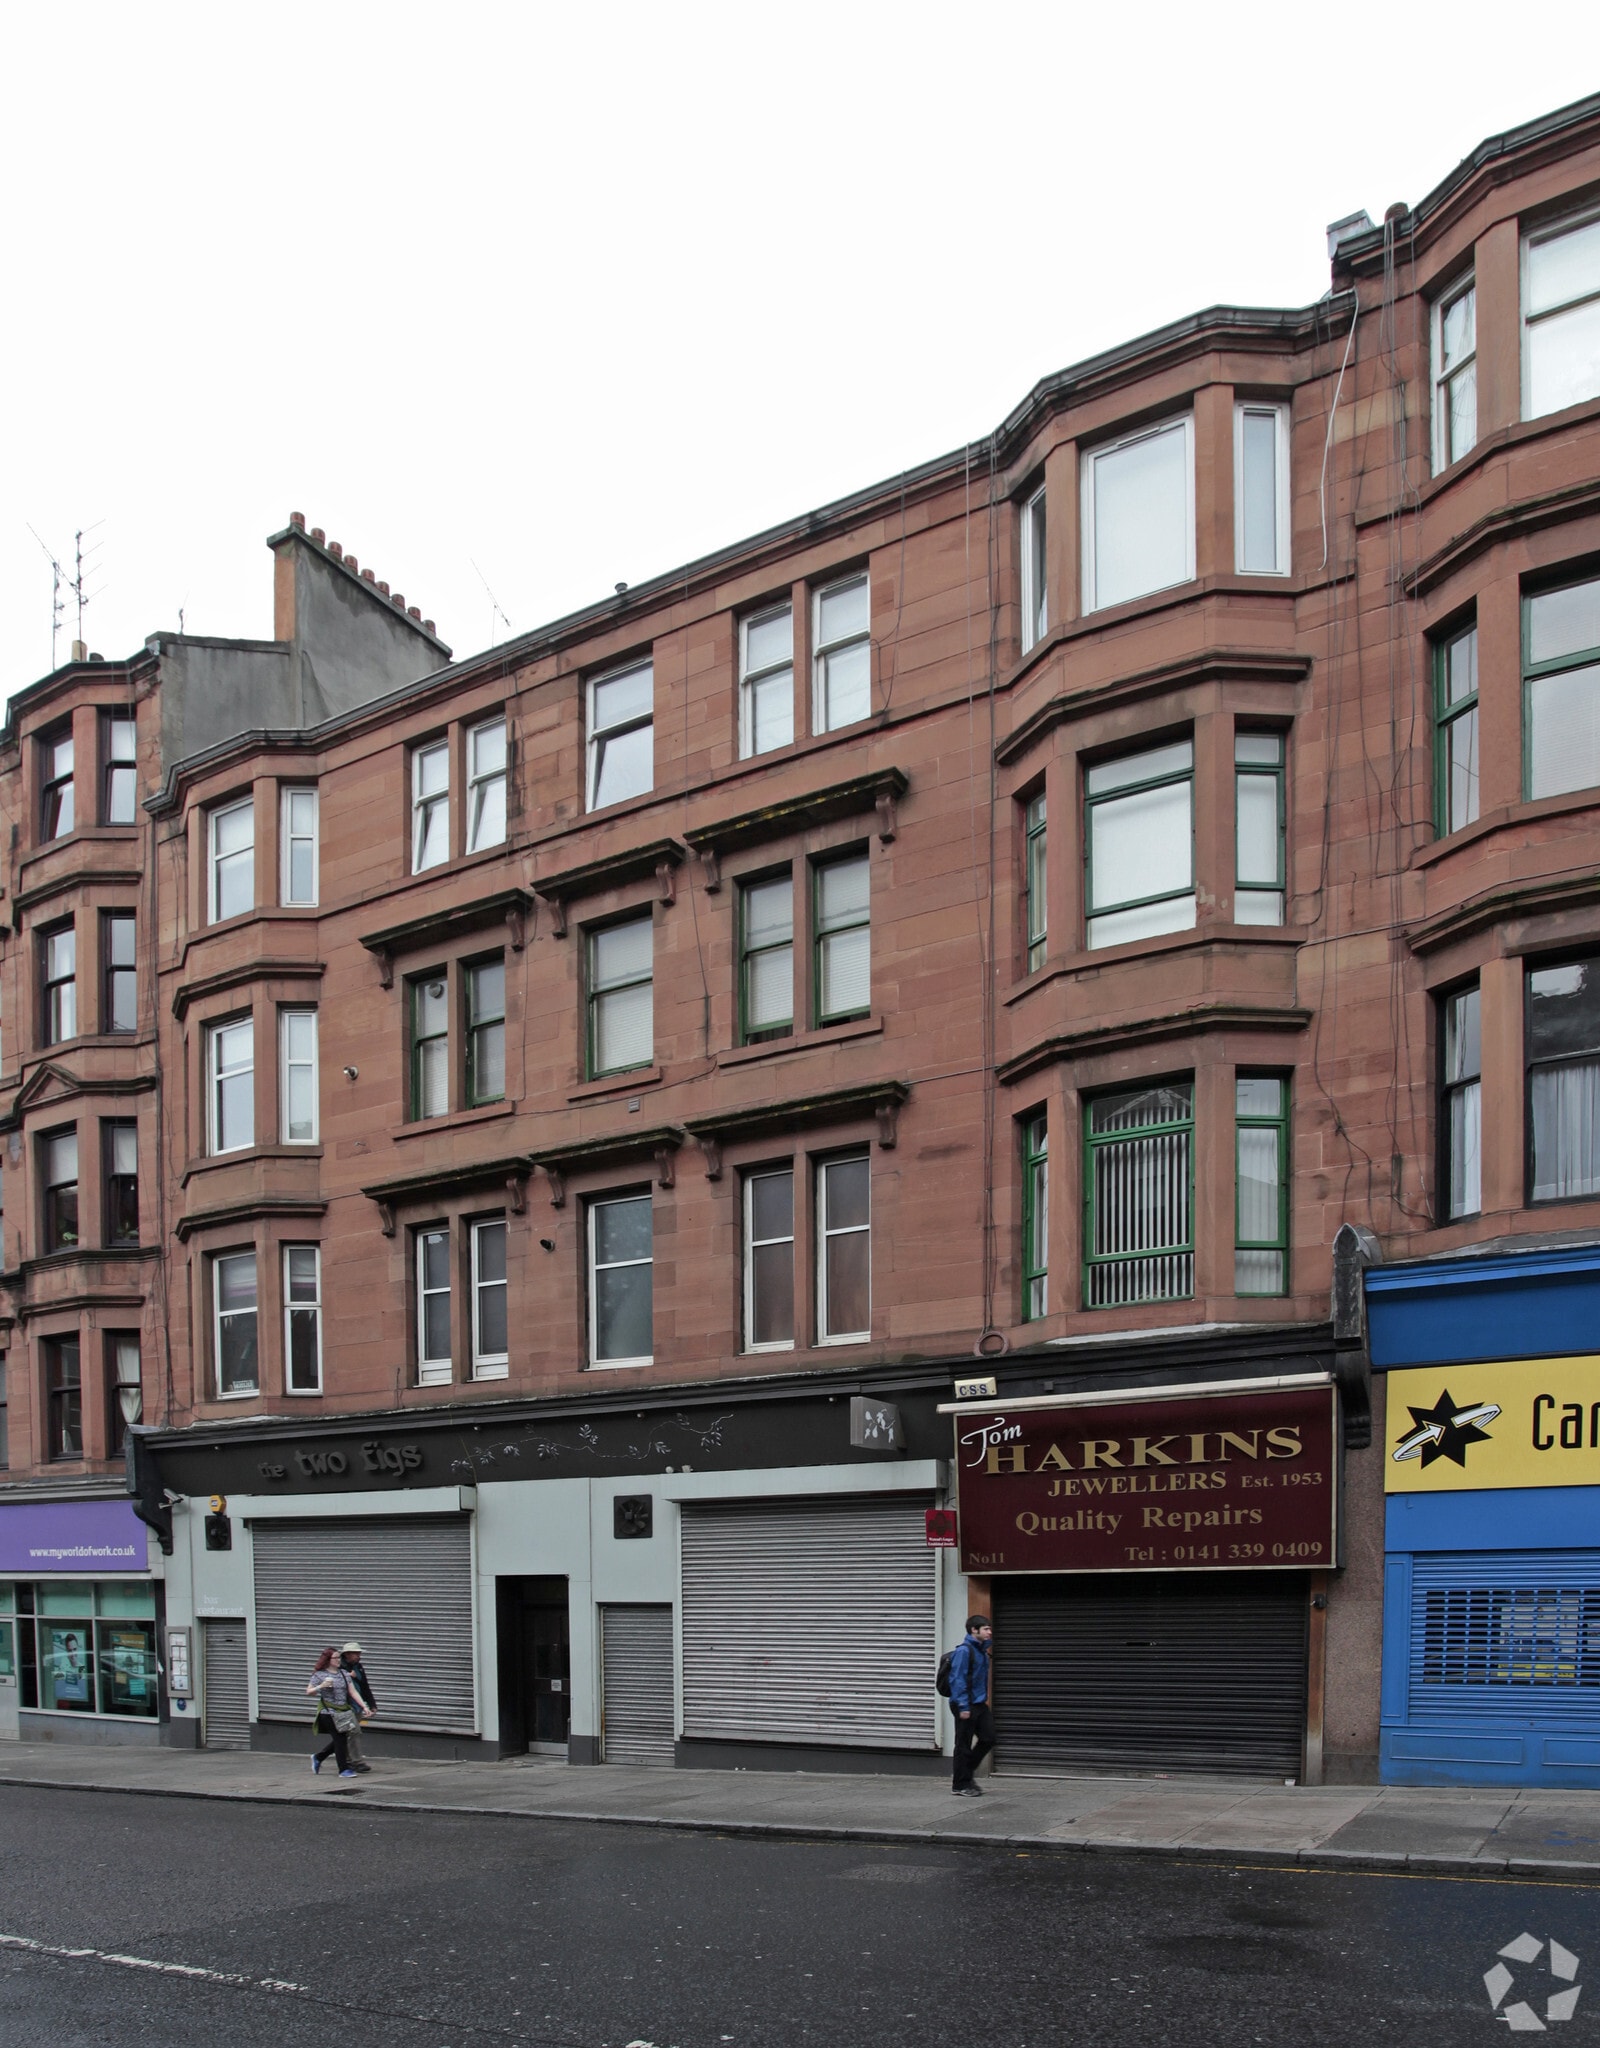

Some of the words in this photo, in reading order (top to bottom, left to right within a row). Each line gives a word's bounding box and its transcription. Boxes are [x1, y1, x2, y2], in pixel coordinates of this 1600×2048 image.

[960, 1417, 1023, 1467] Tom
[983, 1426, 1303, 1474] HARKINS
[257, 1462, 286, 1478] the
[294, 1450, 348, 1476] two
[359, 1441, 423, 1476] figs
[1047, 1470, 1227, 1497] JEWELLERS
[1241, 1475, 1274, 1488] Est.
[1281, 1472, 1323, 1486] 1953
[1015, 1509, 1123, 1536] Quality
[1141, 1504, 1263, 1532] Repairs
[29, 1545, 136, 1559] www.myworldofwork.co.uk
[1125, 1546, 1154, 1561] Tel
[1173, 1545, 1220, 1560] 0141
[1228, 1543, 1265, 1559] 339
[1272, 1541, 1323, 1557] 0409
